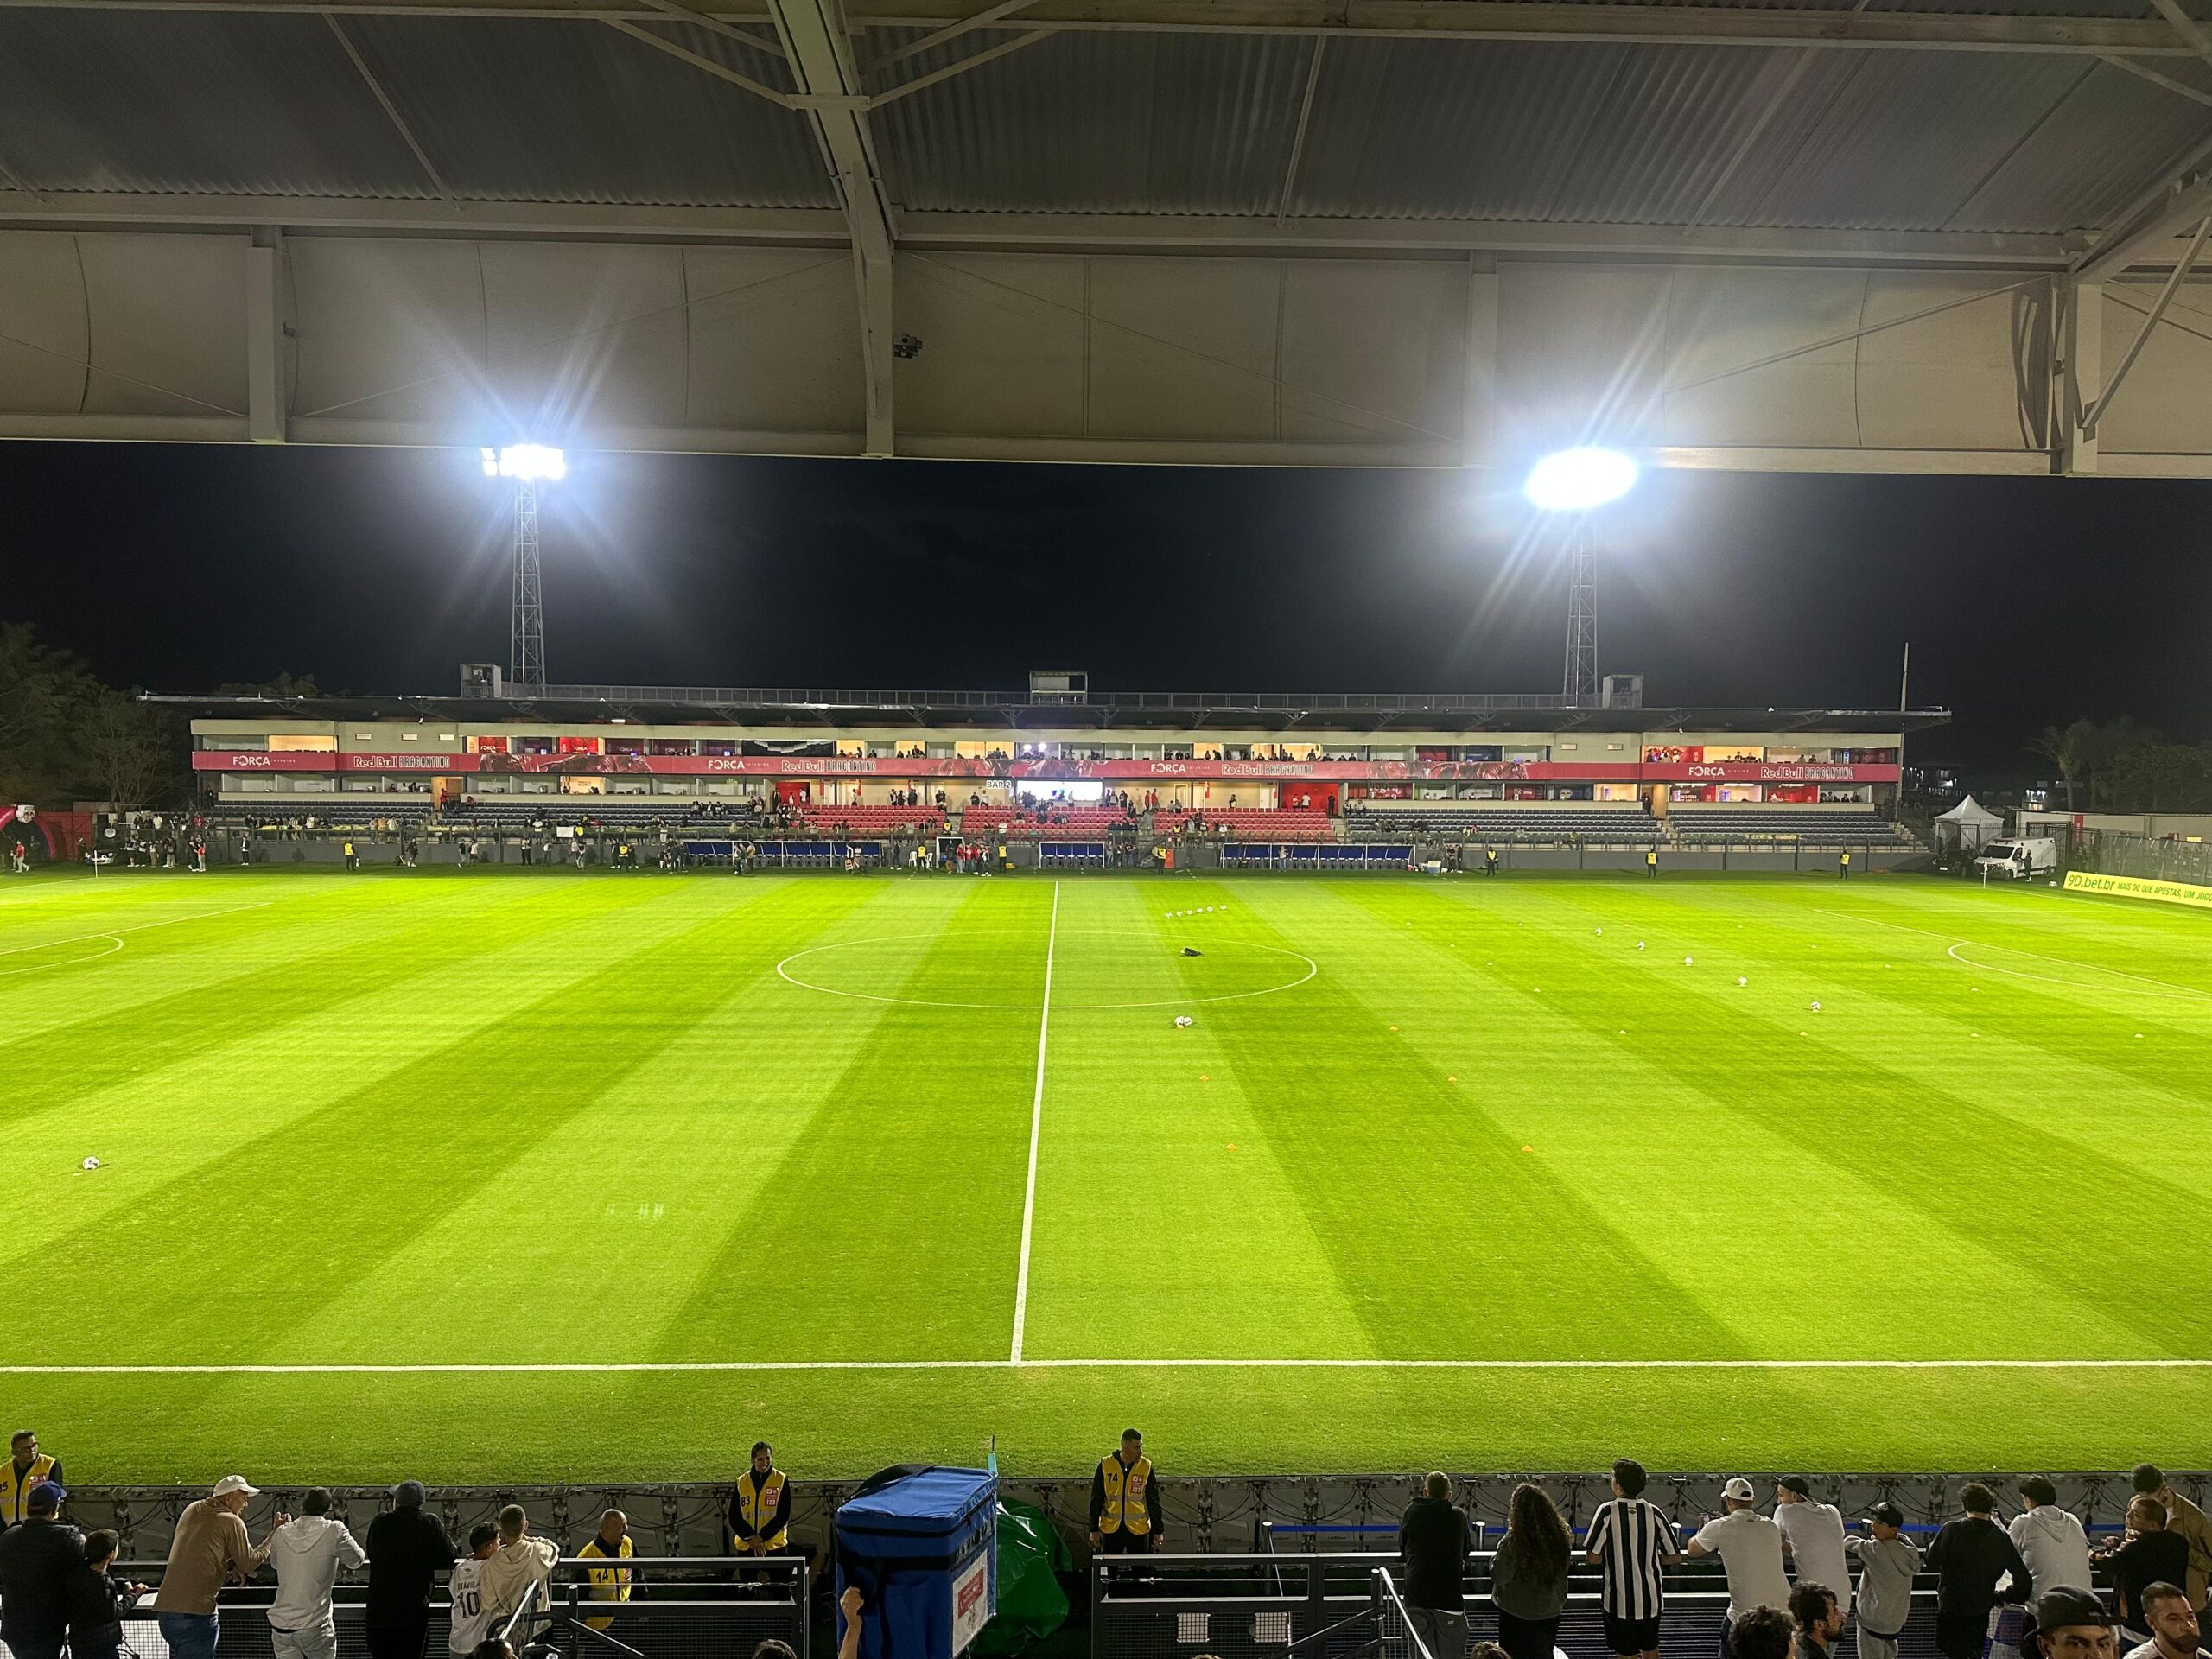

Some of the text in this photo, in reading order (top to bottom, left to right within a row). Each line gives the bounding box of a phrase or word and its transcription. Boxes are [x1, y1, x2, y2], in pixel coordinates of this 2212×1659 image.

[232, 755, 270, 767] FORÇA
[354, 756, 375, 767] Red
[377, 756, 397, 767] Bull
[708, 760, 745, 771] FORÇA
[782, 760, 803, 772] Red
[804, 760, 825, 772] Bull
[1151, 763, 1186, 774] FORÇA
[1222, 764, 1243, 775] Red
[1243, 764, 1263, 775] Bull
[1688, 766, 1725, 778] FORÇA
[1761, 766, 1782, 778] Red
[1783, 766, 1803, 778] Bull
[2068, 874, 2115, 891] 9D.bet.br
[2154, 887, 2182, 899] APOSTAS,
[1107, 1472, 1118, 1483] 74
[741, 1495, 751, 1507] 83
[596, 1568, 608, 1583] 14
[457, 1592, 480, 1618] 10
